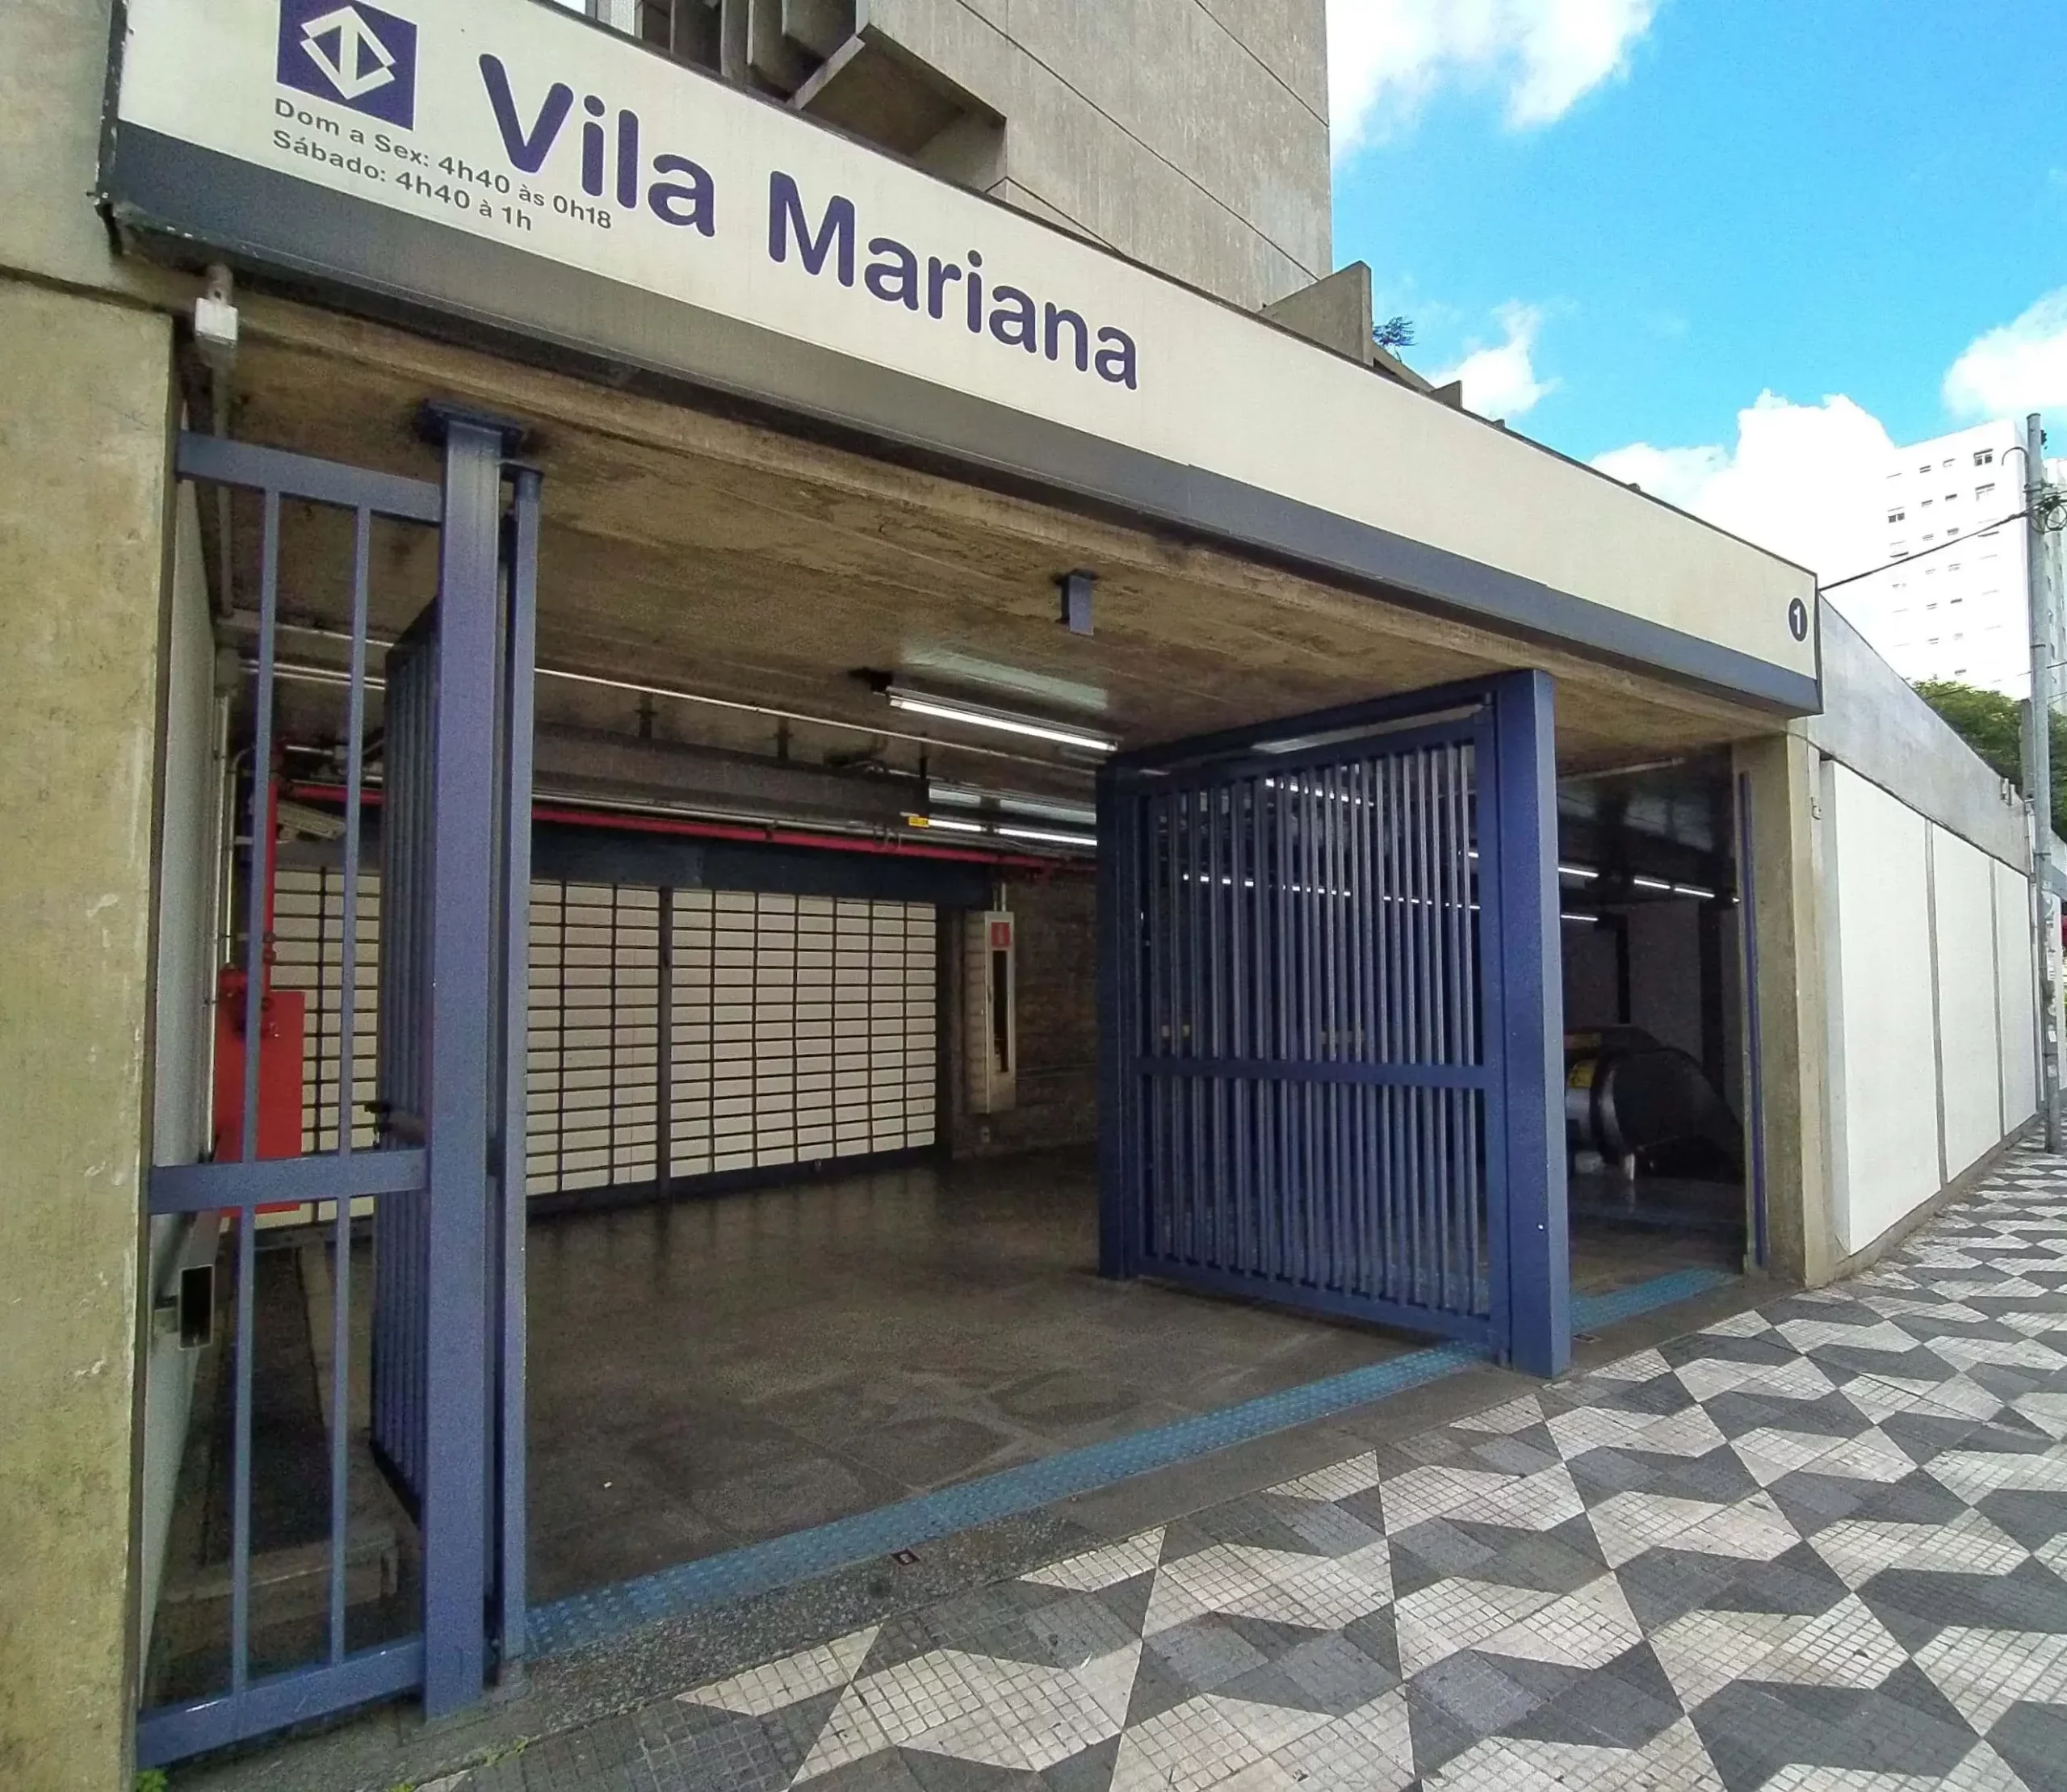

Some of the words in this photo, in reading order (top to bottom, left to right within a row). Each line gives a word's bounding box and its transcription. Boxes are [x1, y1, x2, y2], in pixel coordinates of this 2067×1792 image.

[273, 129, 386, 183] Sábado:
[395, 171, 470, 209] 4h40
[479, 199, 493, 218] à
[501, 206, 531, 231] 1h
[275, 98, 340, 136] Dom
[350, 129, 364, 145] a
[375, 133, 429, 167] Sex:
[438, 156, 510, 195] 4h40
[519, 184, 545, 207] às
[553, 195, 611, 229] 0h18
[478, 53, 715, 237] Vila
[768, 170, 1138, 391] Mariana
